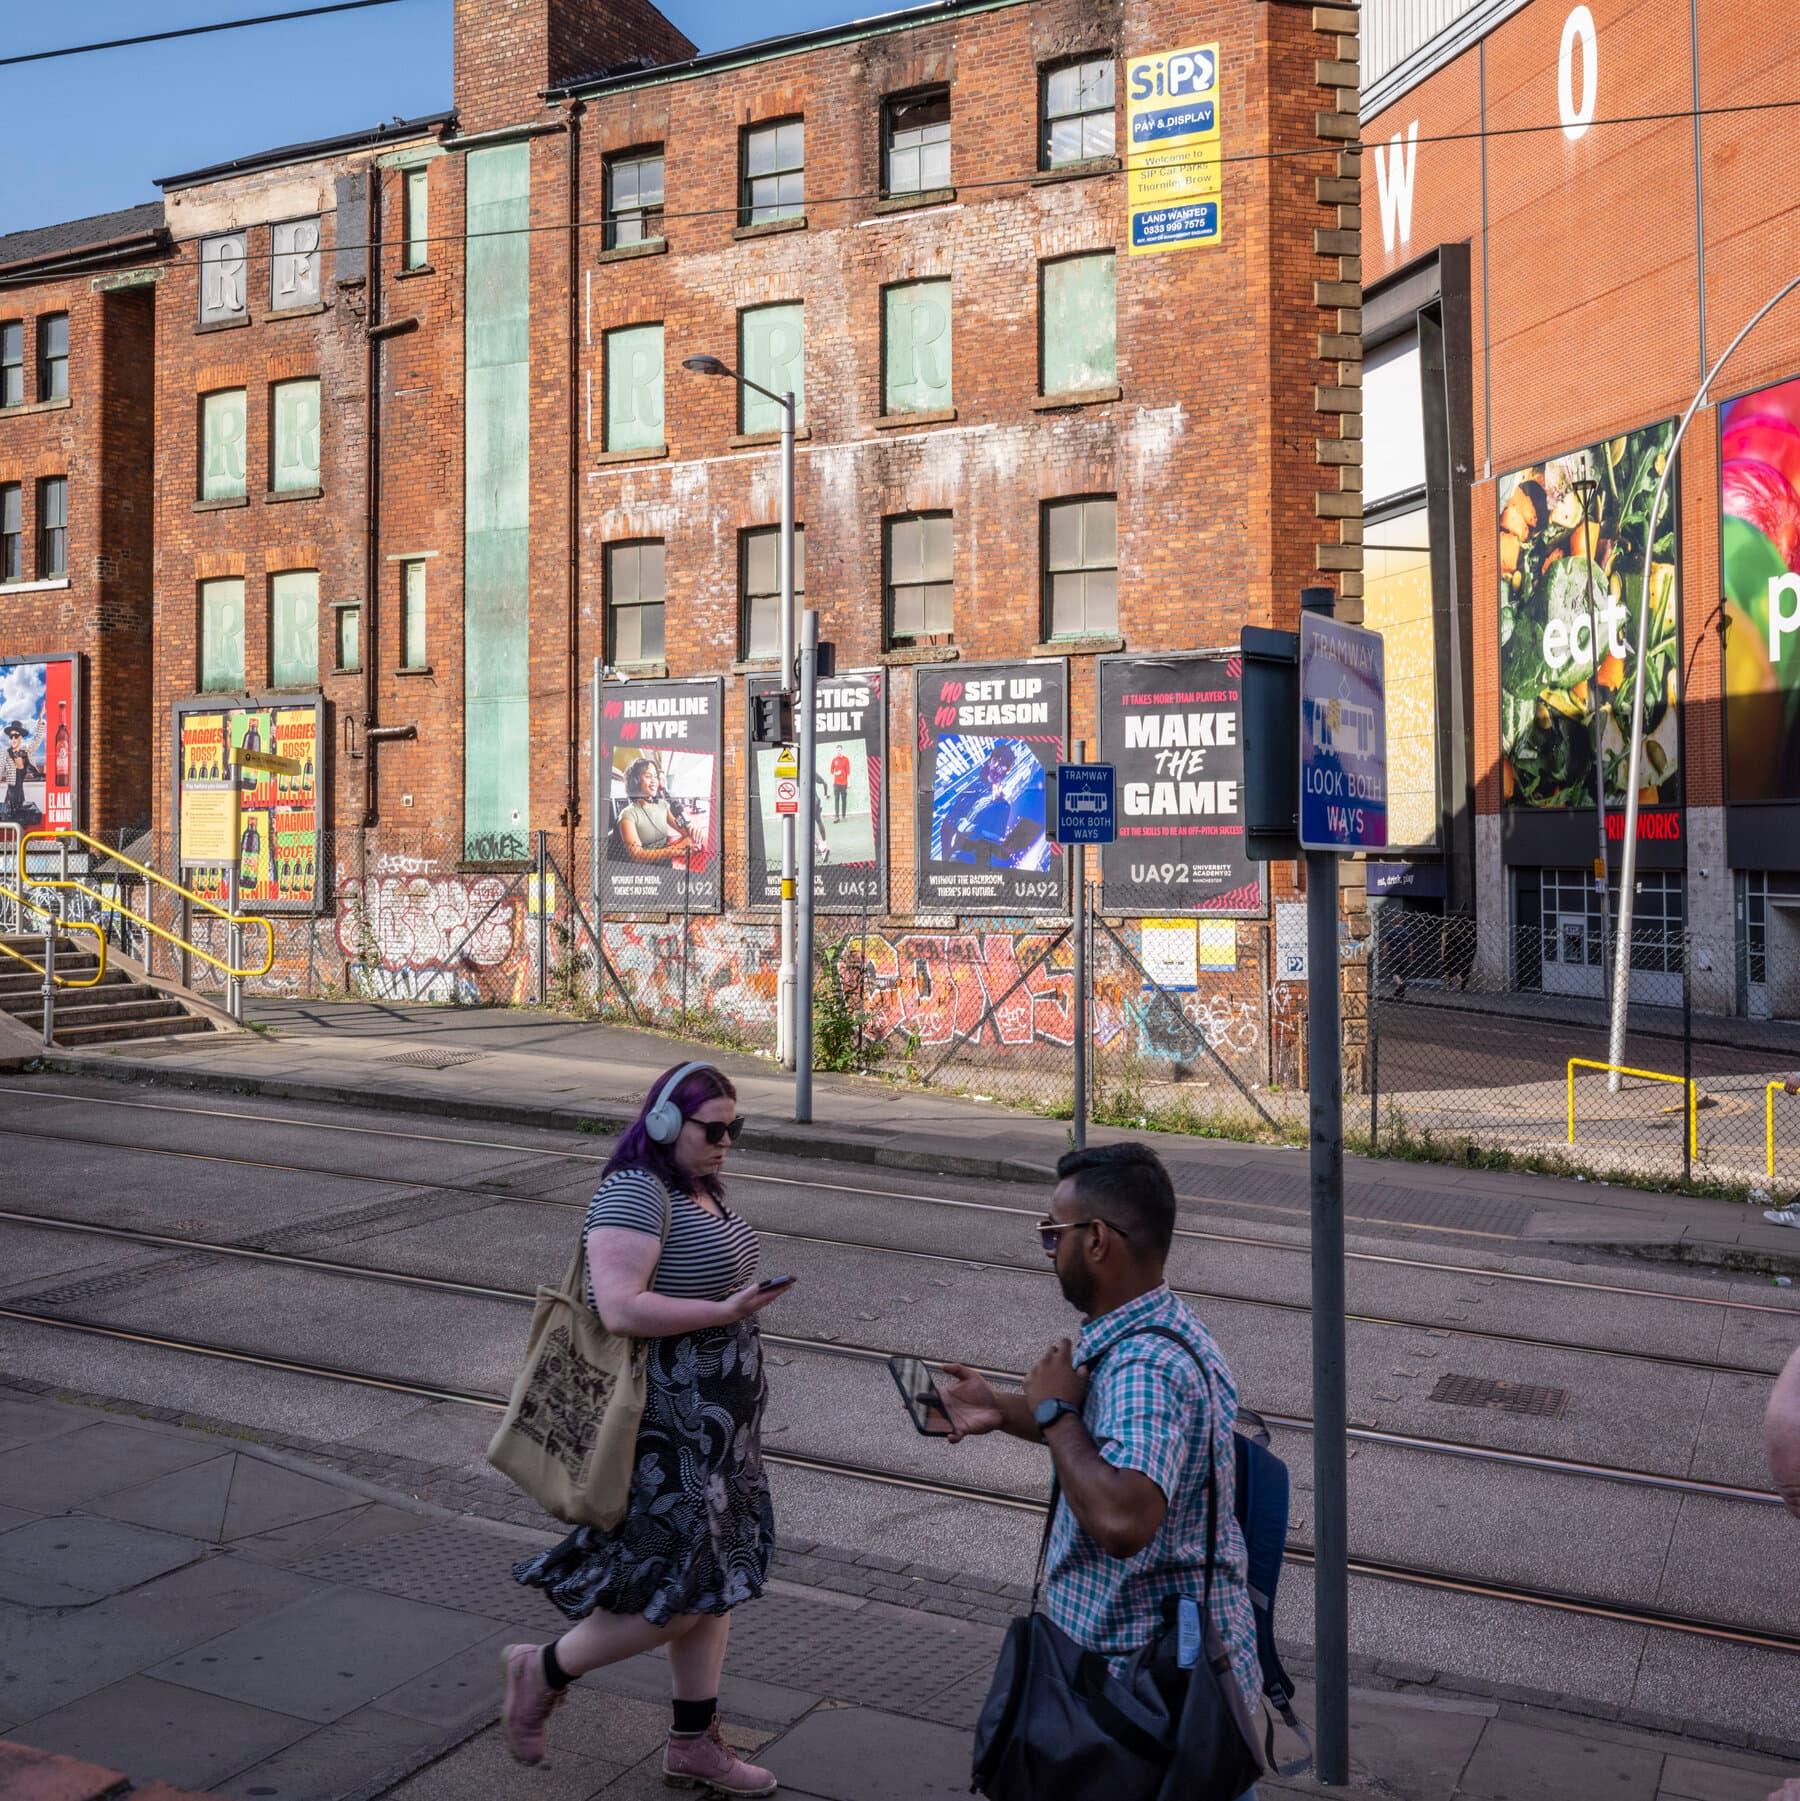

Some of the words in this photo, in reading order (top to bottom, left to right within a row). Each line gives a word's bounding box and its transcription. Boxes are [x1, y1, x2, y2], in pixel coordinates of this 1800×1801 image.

[1134, 120, 1155, 133] PAY
[1157, 118, 1165, 129] &
[1167, 110, 1212, 127] DISPLAY
[1145, 152, 1190, 166] Welcome
[1193, 150, 1203, 159] to
[1160, 166, 1176, 177] Car
[1138, 179, 1184, 193] Thornile
[1185, 175, 1212, 185] Brow
[1142, 213, 1166, 225] LAND
[1168, 207, 1208, 221] WANTED
[1144, 224, 1165, 235] 0333
[1166, 222, 1183, 232] 999
[1184, 218, 1206, 229] 7575
[1543, 594, 1627, 669] eat
[1312, 631, 1375, 670] TRAMWAY
[964, 679, 1005, 702] SET
[1010, 678, 1042, 699] UP
[1122, 695, 1130, 706] IT
[1131, 694, 1152, 705] TAKES
[1153, 693, 1174, 705] MORE
[1175, 691, 1195, 703] THAN
[1196, 690, 1227, 703] PLAYERS
[1228, 690, 1238, 701] TO
[624, 696, 709, 718] HEADLINE
[794, 688, 870, 710] TICS
[958, 702, 1048, 726] SEASON
[184, 728, 224, 745] MAGGIES
[276, 723, 316, 740] MAGGIES
[640, 720, 688, 740] HYPE
[1124, 712, 1236, 749] MAKE
[190, 746, 217, 762] BOSS?
[283, 742, 311, 758] BOSS?
[1154, 748, 1207, 781] THE
[1065, 770, 1108, 781] TRAMWAY
[1307, 767, 1343, 797] LOOK
[1348, 772, 1382, 801] BOTH
[48, 792, 56, 808] EL
[1123, 780, 1238, 816] GAME
[1061, 817, 1085, 827] LOOK
[1088, 817, 1111, 827] BOTH
[1327, 805, 1364, 833] WAYS
[1074, 829, 1099, 839] WAYS
[1119, 826, 1130, 837] GET
[1142, 826, 1161, 836] SKILLS
[1162, 826, 1169, 836] TO
[1170, 826, 1178, 836] BE
[1179, 826, 1187, 836] AN
[1188, 825, 1218, 836] OFF-PITCH
[1219, 825, 1244, 835] SUCCESS
[275, 846, 313, 859] ROUTE
[929, 874, 957, 885] WITHOUT
[957, 874, 969, 885] THE
[1131, 863, 1189, 884] UA92
[676, 881, 713, 896] UA92
[839, 881, 878, 896] UA92
[938, 887, 962, 897] THERE'S
[962, 887, 971, 896] NO
[972, 887, 997, 896] FUTURE.
[1015, 881, 1058, 897] UA92
